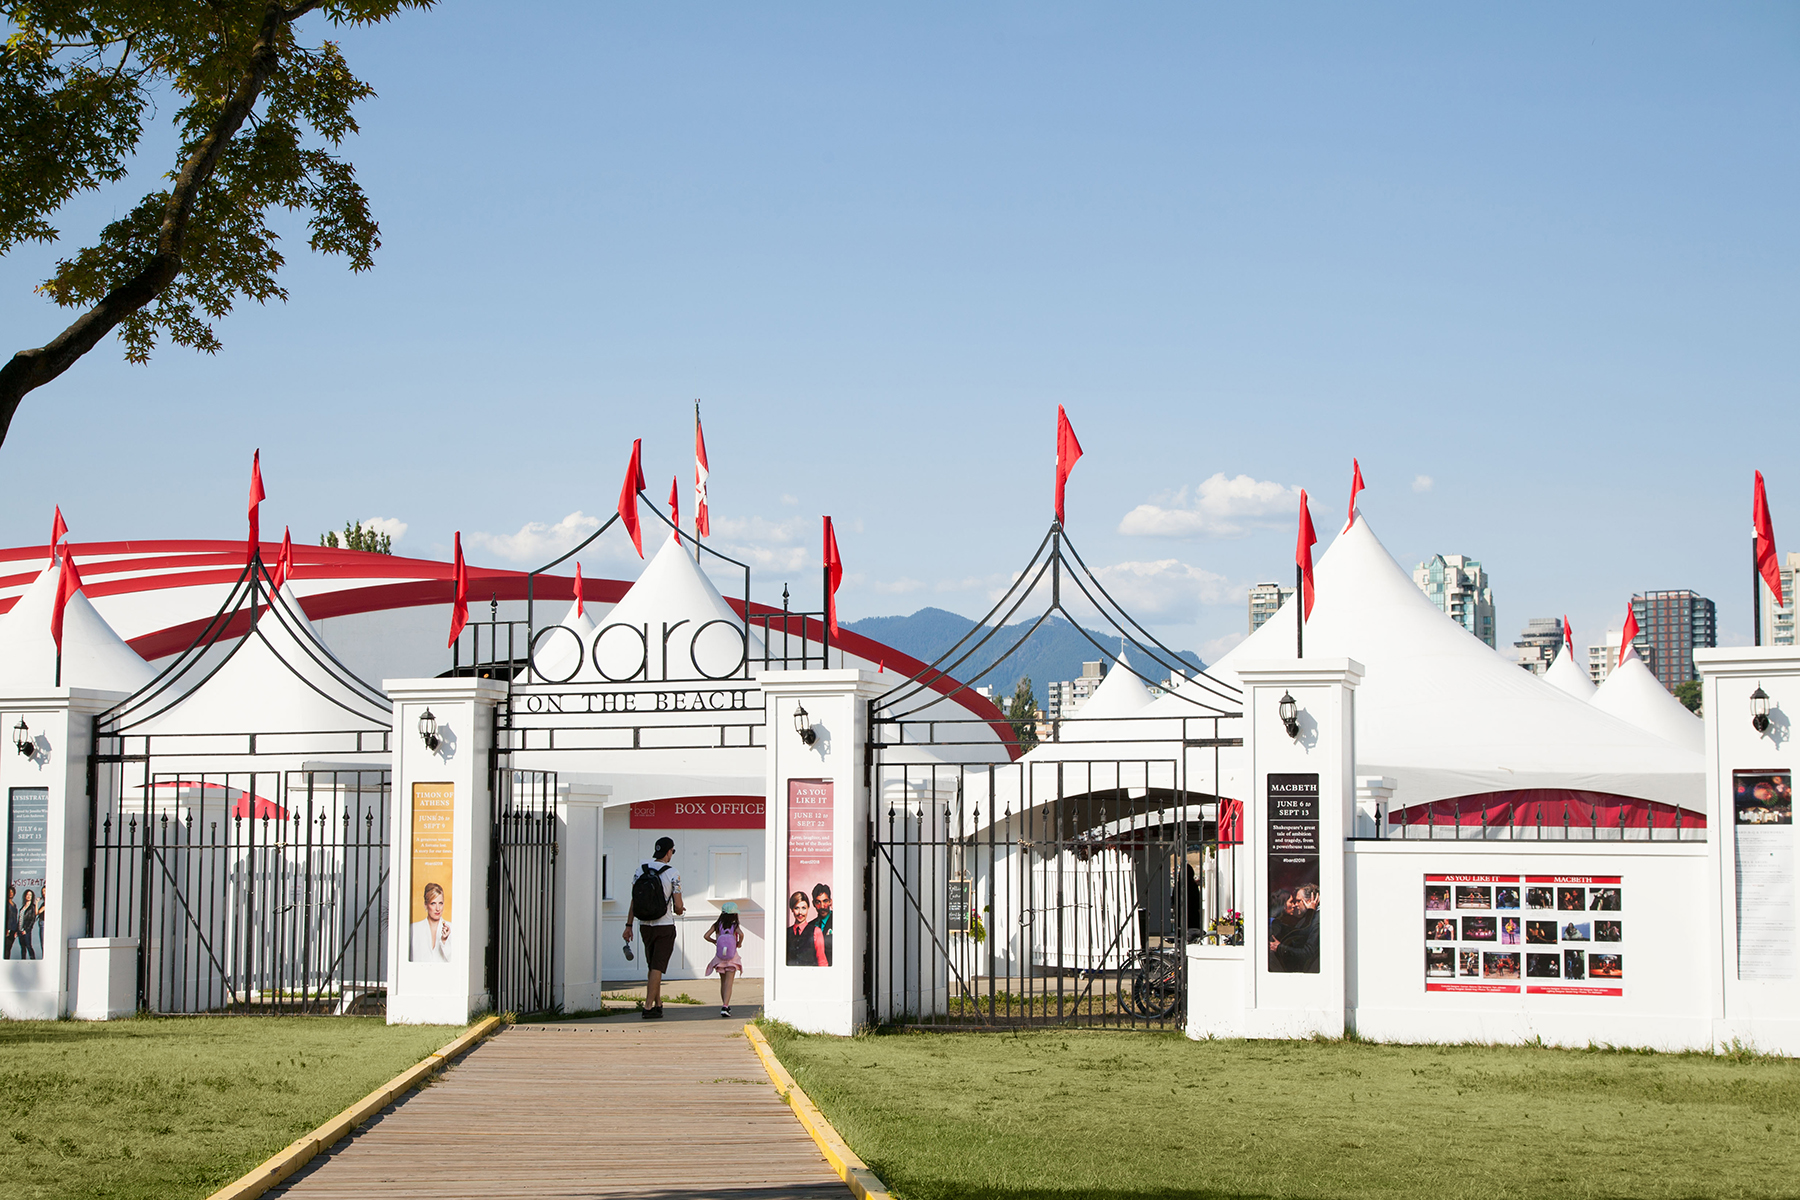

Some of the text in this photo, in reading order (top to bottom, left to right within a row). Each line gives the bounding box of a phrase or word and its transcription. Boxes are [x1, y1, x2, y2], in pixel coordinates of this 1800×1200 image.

[528, 618, 749, 683] bard
[527, 691, 748, 712] ON THE BEACH
[634, 803, 655, 815] bard
[675, 803, 765, 815] BOX OFFICE
